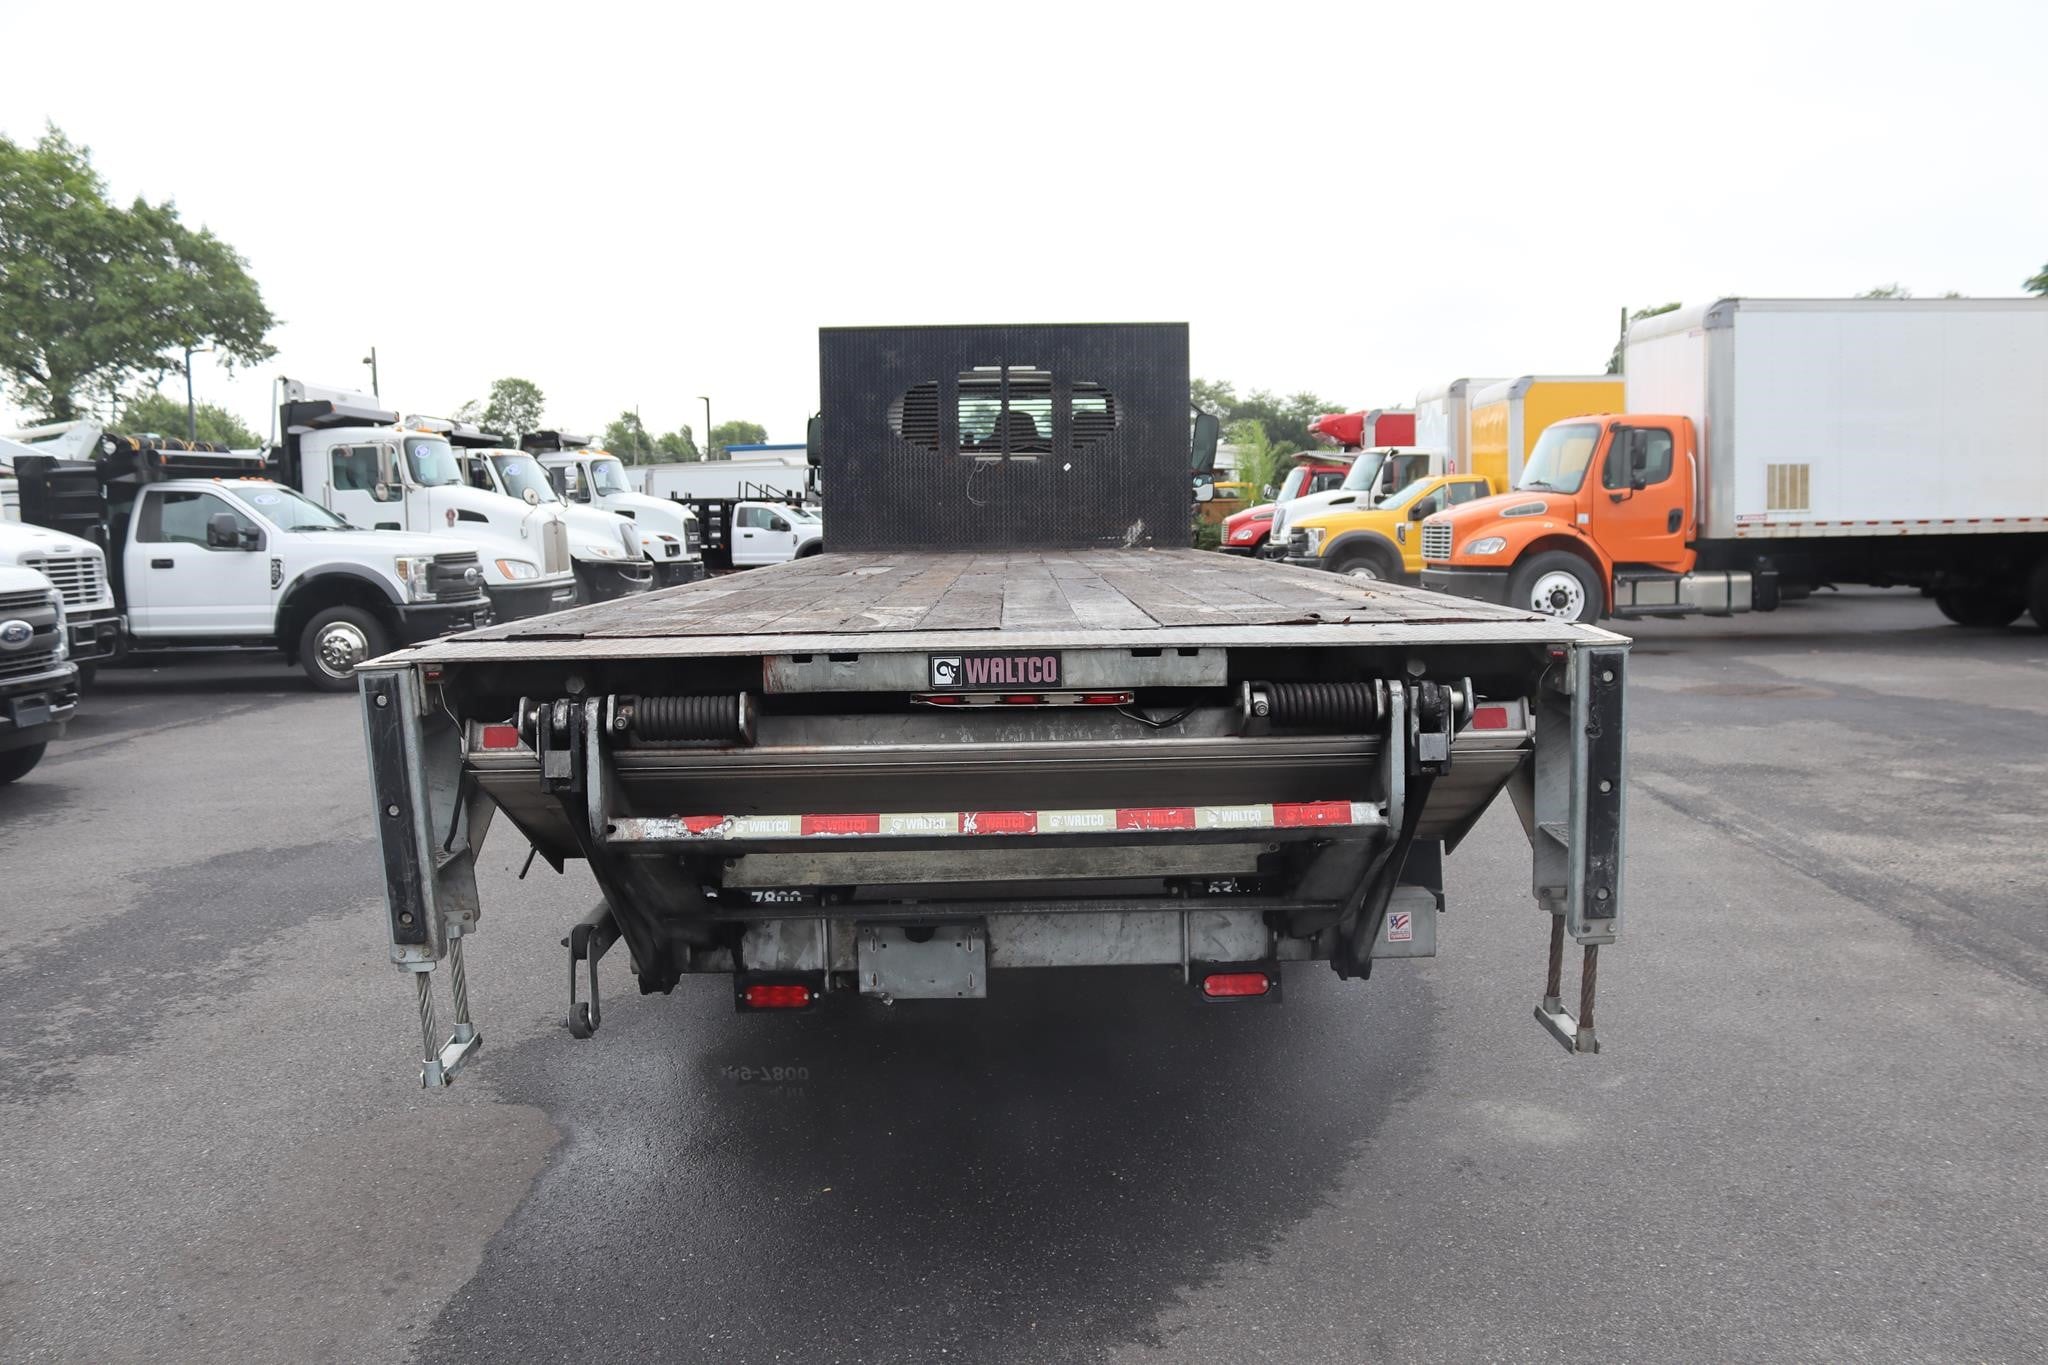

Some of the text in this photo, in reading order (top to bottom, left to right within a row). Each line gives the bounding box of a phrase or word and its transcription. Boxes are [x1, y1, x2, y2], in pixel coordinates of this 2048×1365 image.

[965, 656, 1057, 684] WALTCO
[906, 817, 946, 830] WALTCO
[1064, 814, 1104, 827] WALTCO
[1221, 810, 1262, 823] WALTCO
